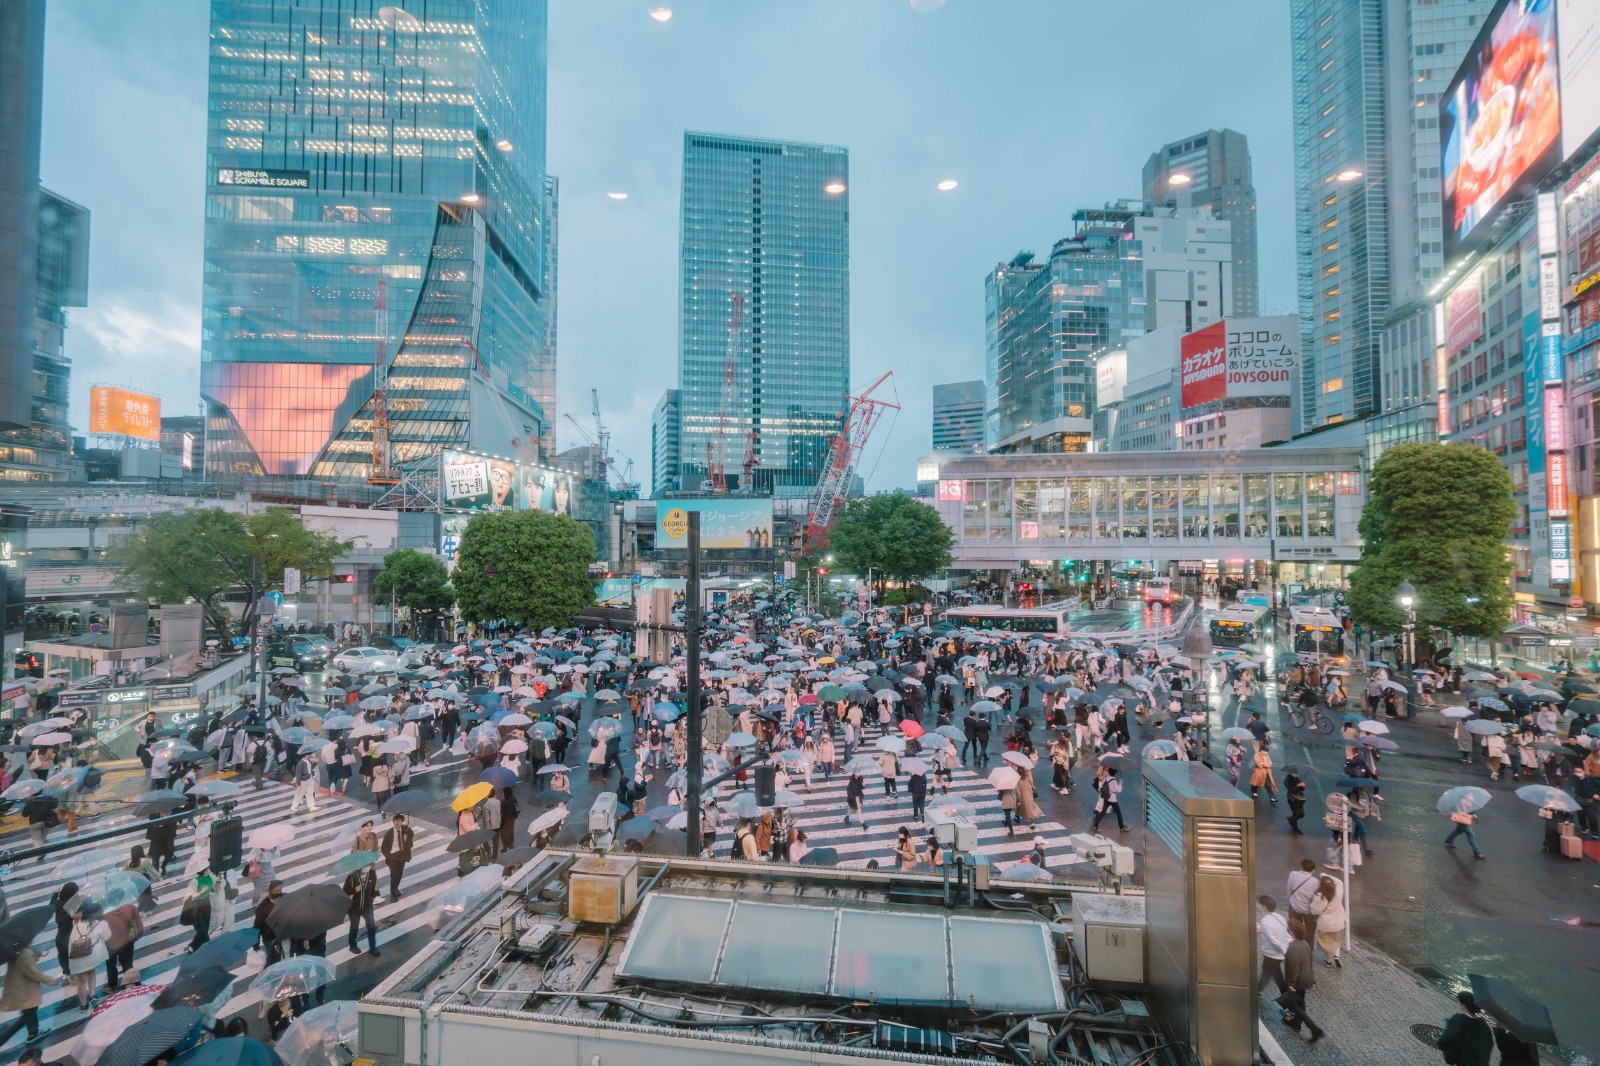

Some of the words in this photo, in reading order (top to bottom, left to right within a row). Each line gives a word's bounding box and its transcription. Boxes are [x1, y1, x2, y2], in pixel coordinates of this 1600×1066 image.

[235, 170, 268, 178] SHIBUYA
[234, 177, 275, 186] SCRAMBLE
[275, 178, 308, 187] SQUARE
[1228, 331, 1282, 344] ココロの
[1228, 344, 1298, 358] ボリューム、
[1183, 346, 1225, 374] カラオケ
[1228, 358, 1299, 370] あげていこう。
[1183, 363, 1226, 386] JOYSOUND
[1526, 332, 1542, 448] アイシティ
[62, 575, 81, 586] JR
